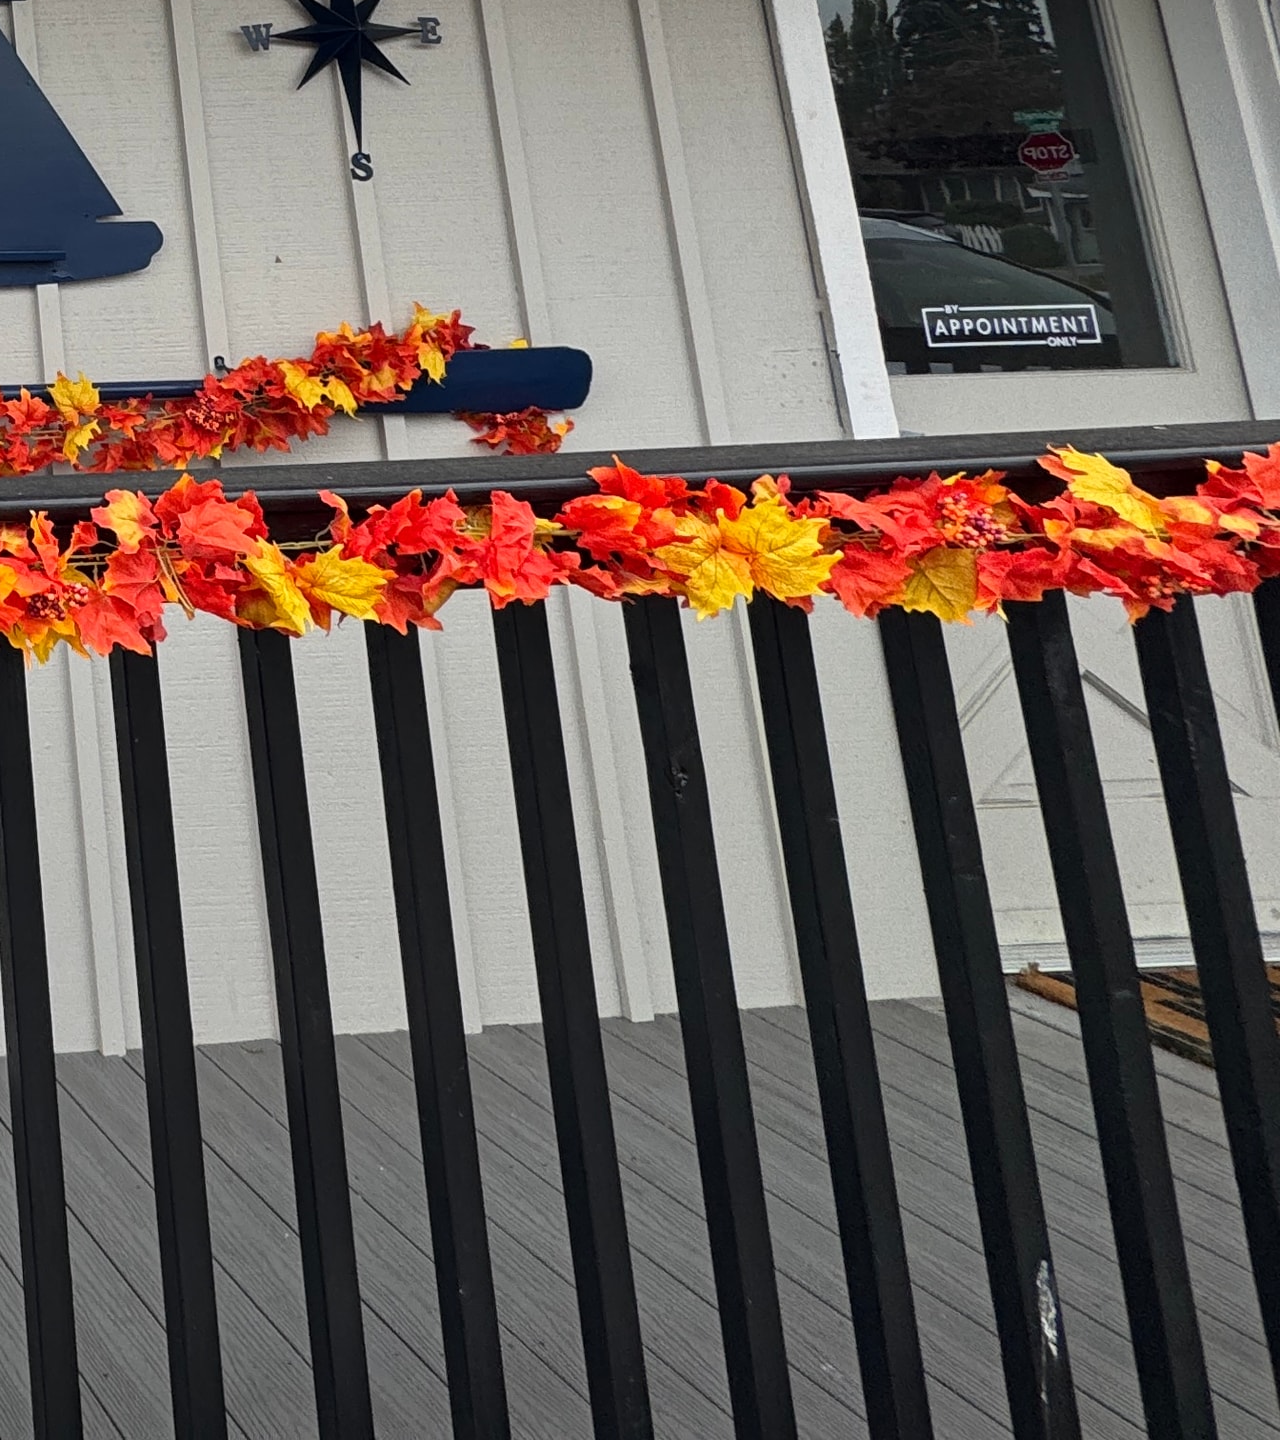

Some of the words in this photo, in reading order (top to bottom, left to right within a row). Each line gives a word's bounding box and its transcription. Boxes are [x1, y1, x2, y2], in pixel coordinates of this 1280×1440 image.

[240, 22, 273, 51] W
[417, 16, 442, 44] E
[350, 152, 374, 181] S
[944, 305, 959, 314] BY
[935, 316, 1089, 336] APPOINTMENT
[1047, 337, 1078, 347] ONLY
